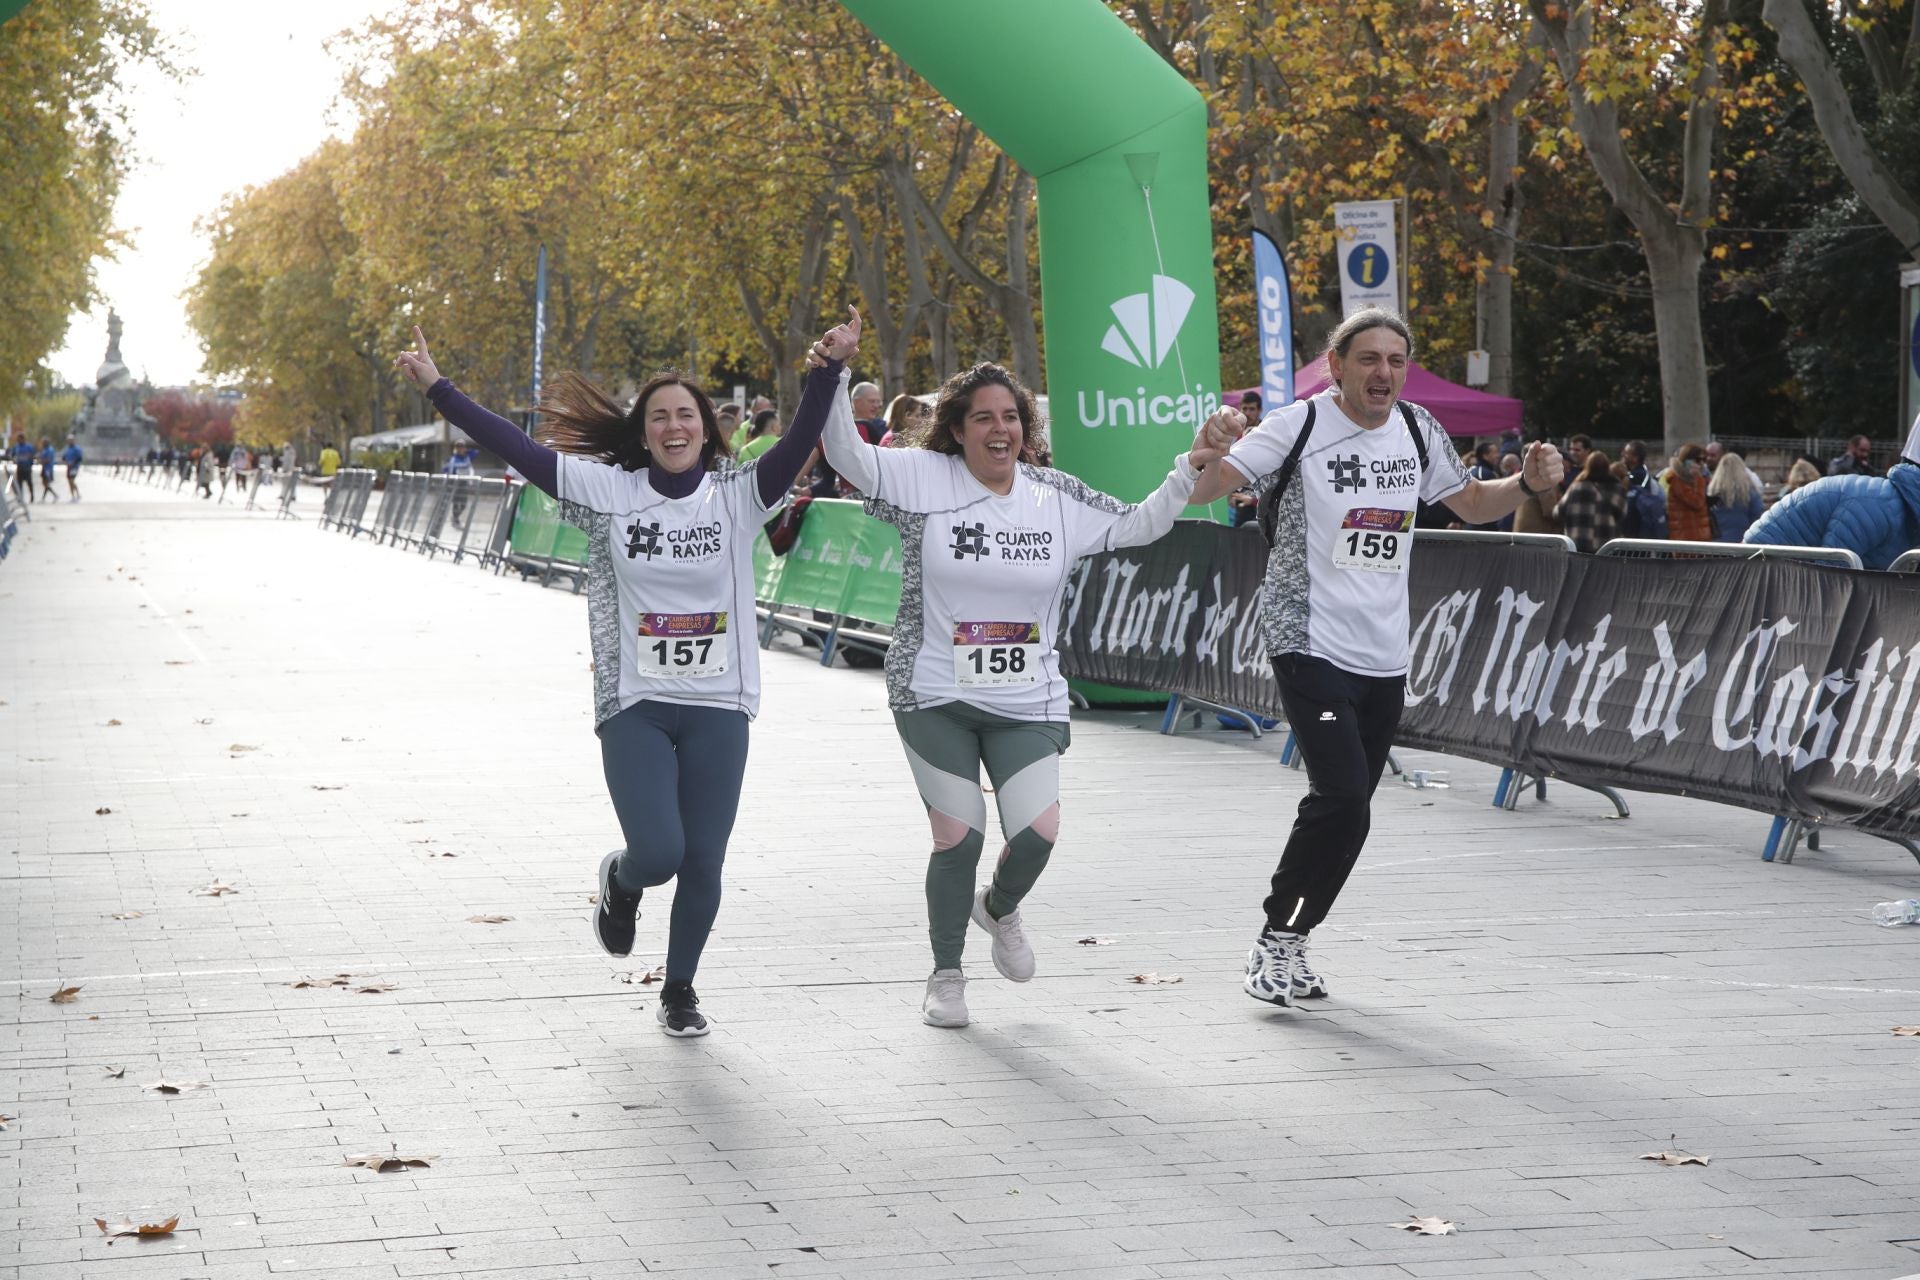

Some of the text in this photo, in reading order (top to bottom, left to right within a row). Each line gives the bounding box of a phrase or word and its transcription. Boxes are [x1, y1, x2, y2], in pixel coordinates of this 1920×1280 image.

[1369, 210, 1378, 218] de
[1077, 383, 1217, 433] Unicaja
[1370, 457, 1417, 474] CUATRO
[1376, 473, 1416, 489] RAYAS
[667, 521, 722, 543] CUATRO
[995, 531, 1053, 546] CUATRO
[672, 538, 721, 558] RAYAS
[1001, 547, 1051, 561] RAYAS
[1346, 531, 1398, 560] 159
[1090, 557, 1199, 658] Norte
[656, 615, 668, 628] 9ª
[971, 624, 983, 637] 9ª
[652, 638, 713, 666] 157
[968, 647, 1025, 674] 158
[1403, 588, 1481, 707] El
[1472, 586, 1627, 736] Norte
[1627, 620, 1707, 746] de
